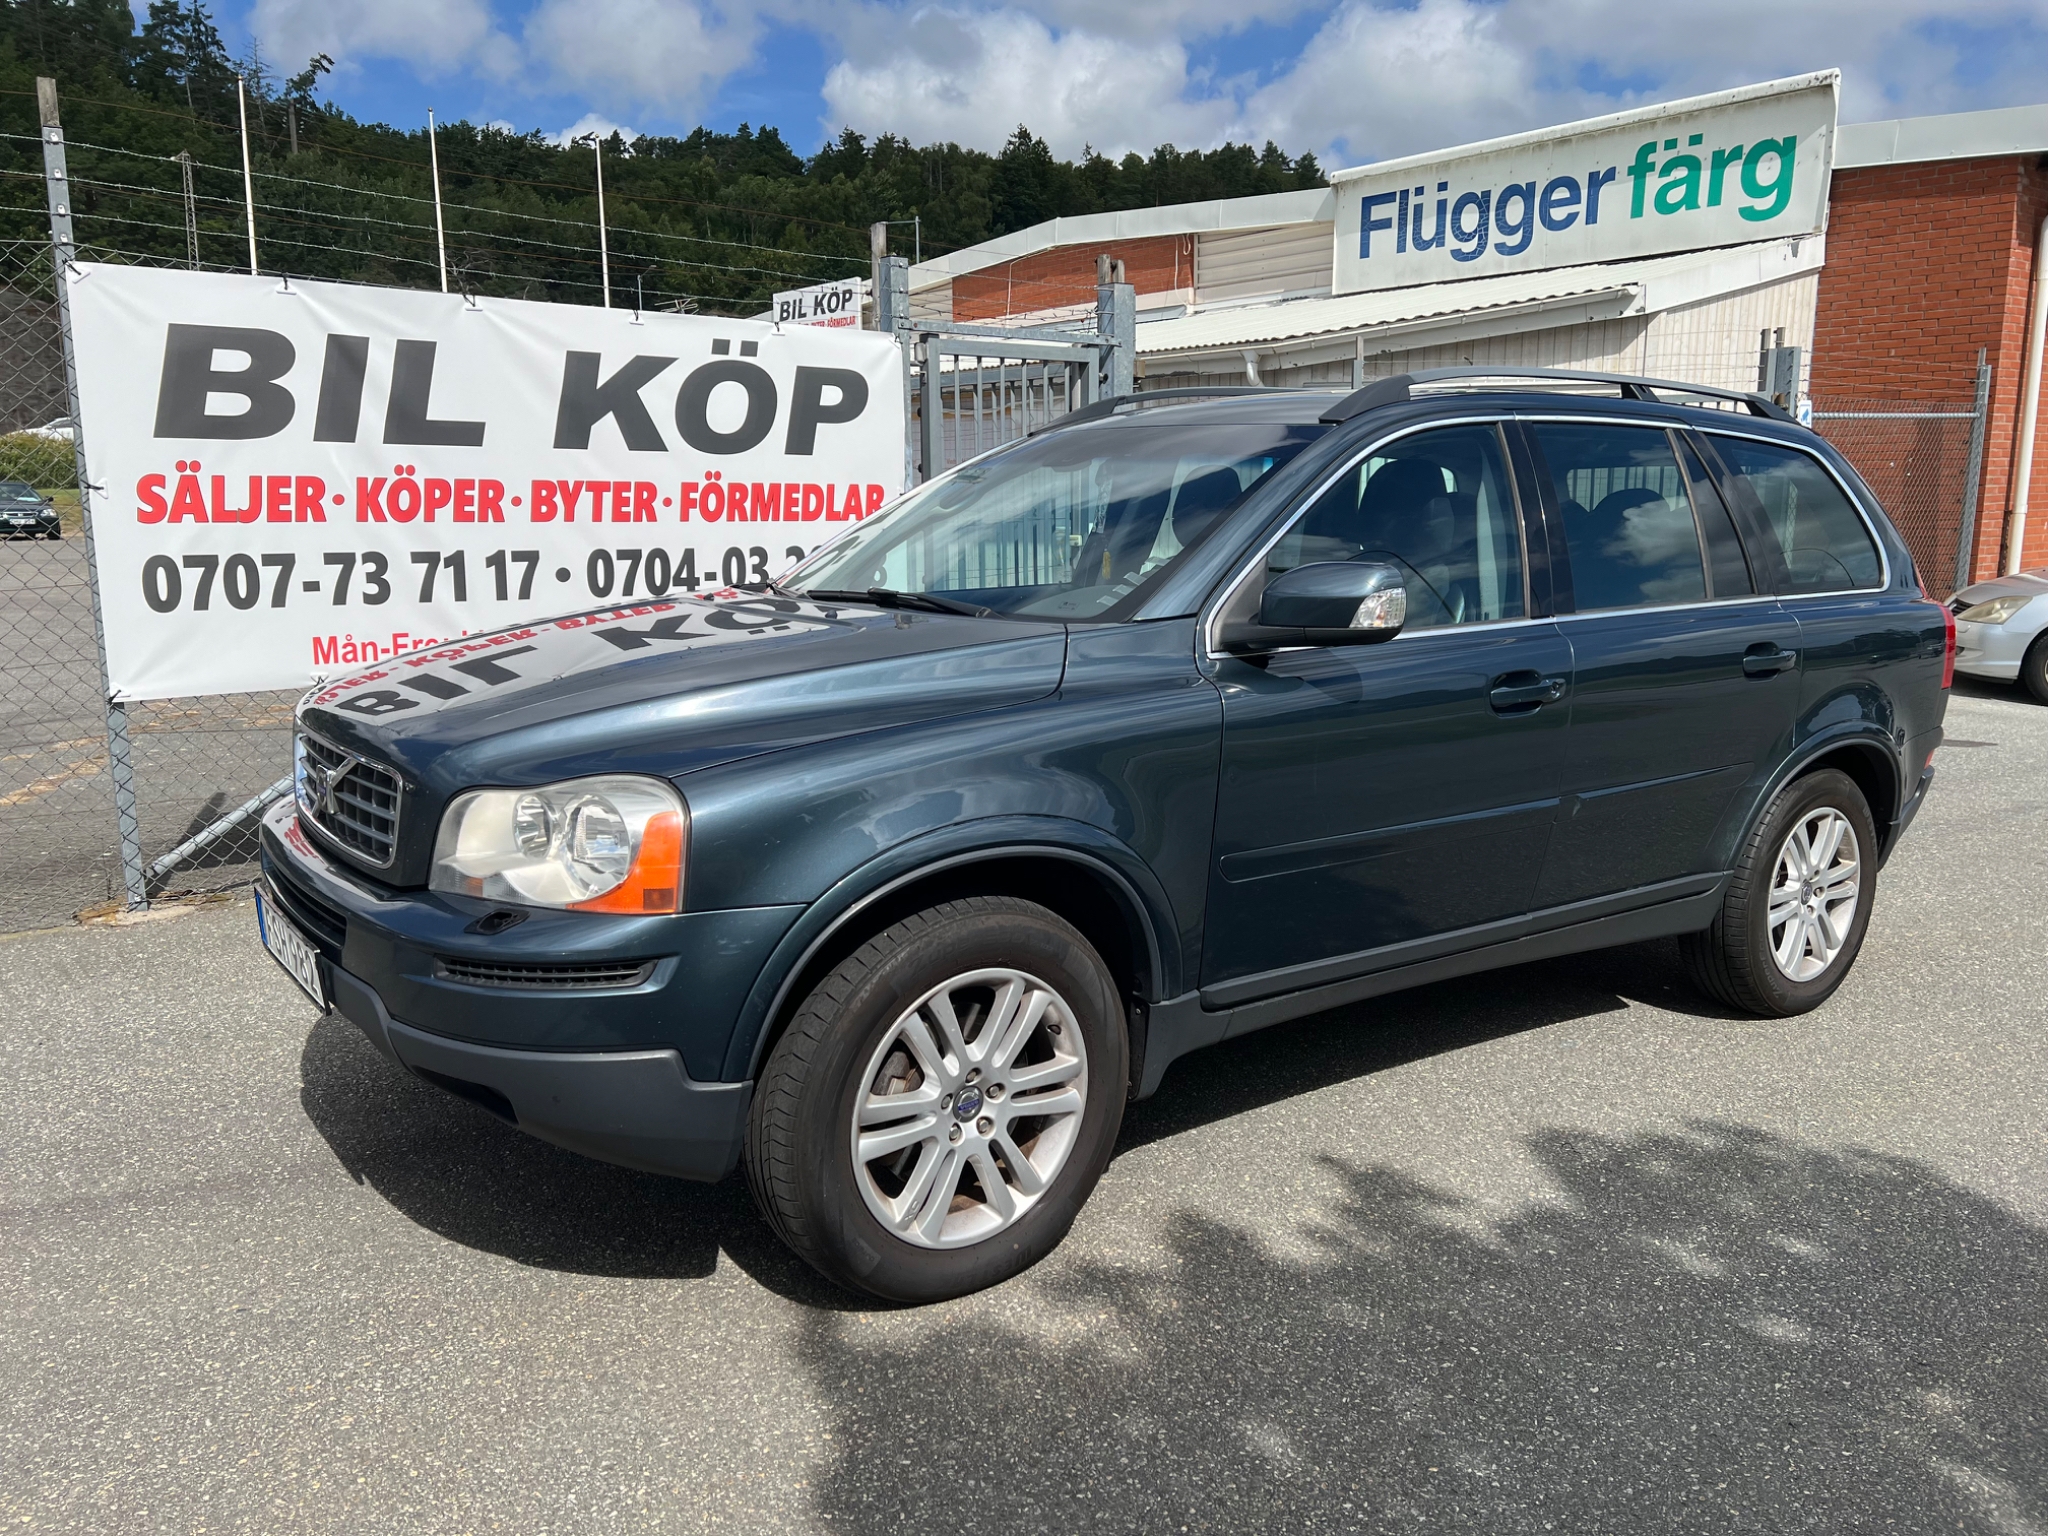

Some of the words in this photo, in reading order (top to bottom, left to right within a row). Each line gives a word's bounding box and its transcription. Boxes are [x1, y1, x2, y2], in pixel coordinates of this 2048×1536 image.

[1359, 166, 1616, 263] Flügger
[1627, 132, 1798, 223] färg
[780, 298, 808, 321] BIL
[813, 286, 853, 316] KÖP
[153, 322, 487, 448] BIL
[552, 338, 869, 456] KÖP
[136, 459, 327, 525] SÄLJER
[356, 464, 505, 524] KÖPER
[530, 479, 658, 523] BYTER
[679, 470, 886, 523] FÖRMEDLAR
[141, 550, 392, 613] 0707-73
[410, 549, 467, 603] 71
[485, 549, 540, 602] 17
[586, 546, 769, 598] 0704-03
